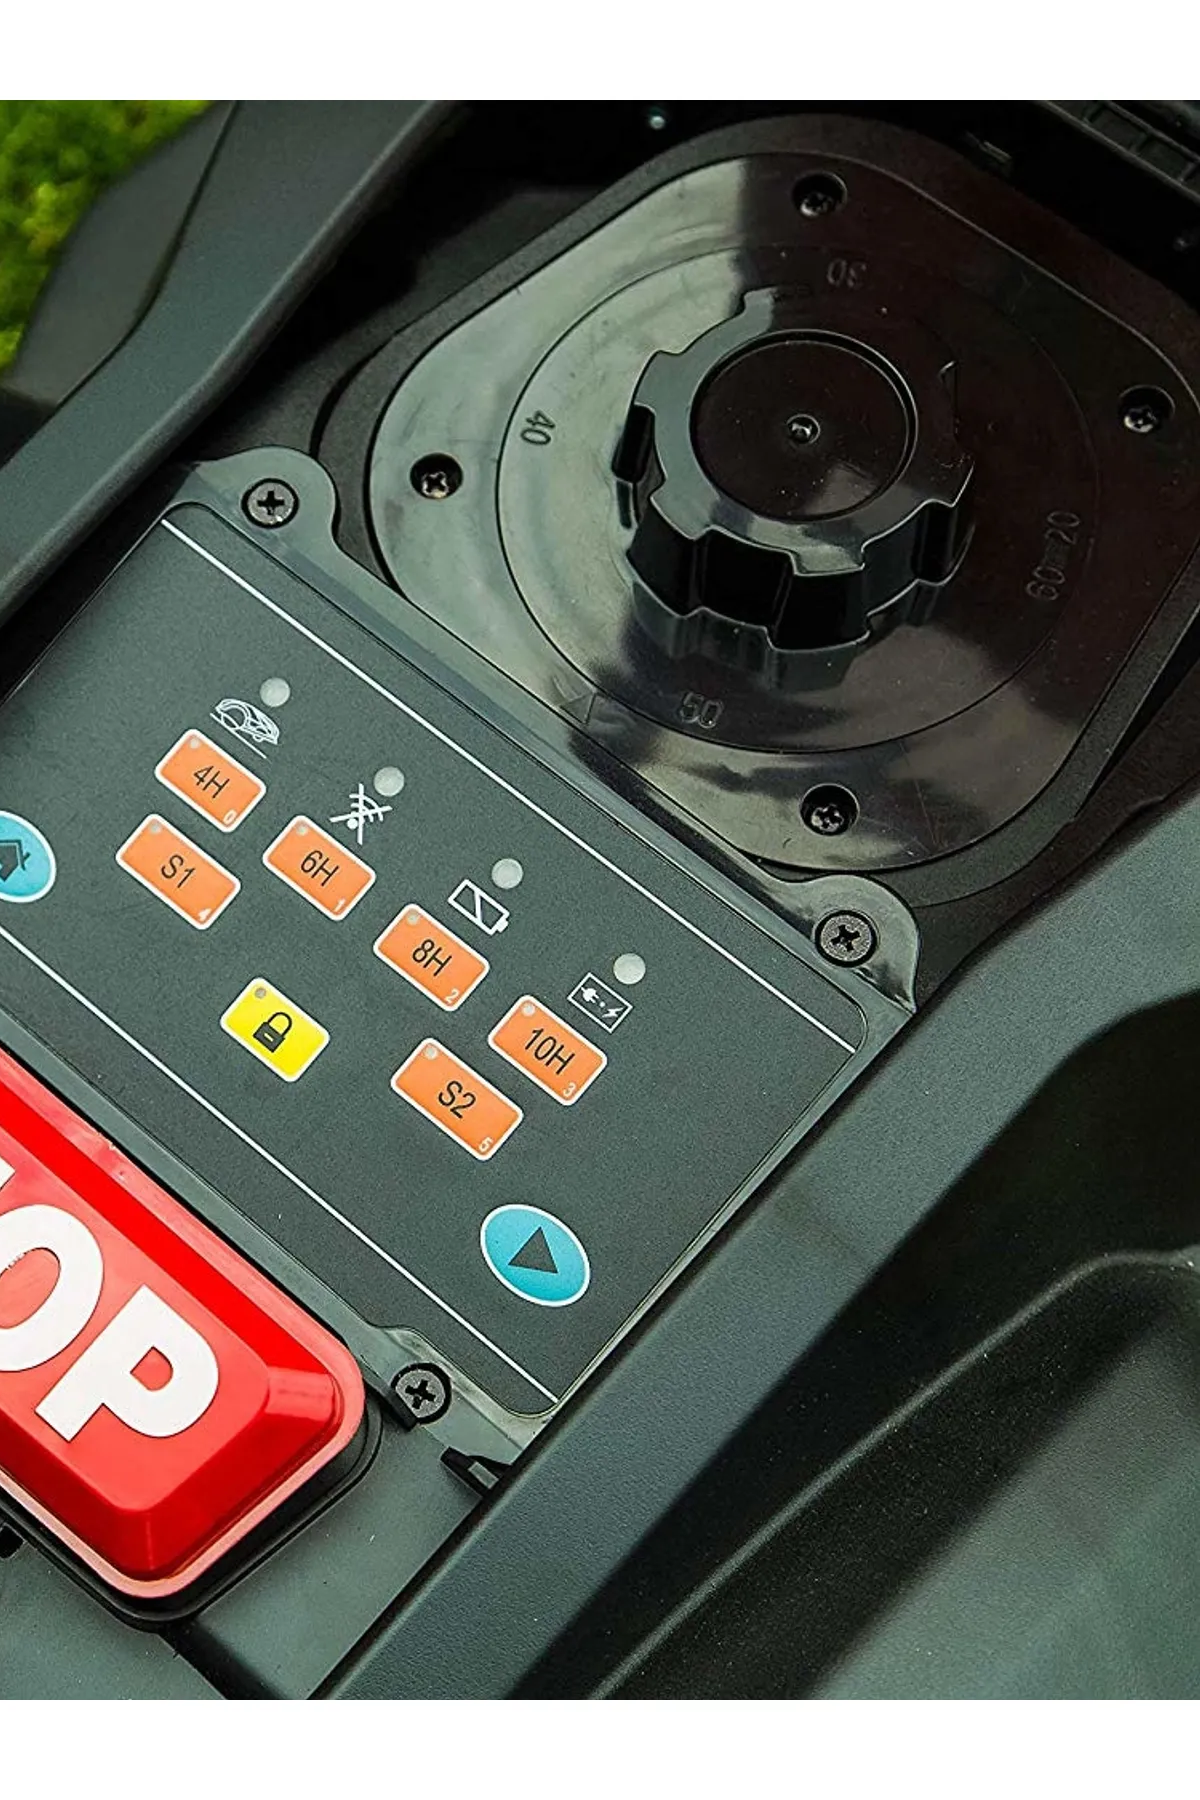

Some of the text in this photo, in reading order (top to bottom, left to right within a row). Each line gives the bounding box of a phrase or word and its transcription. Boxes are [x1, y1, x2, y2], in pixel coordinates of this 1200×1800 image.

[520, 409, 556, 445] 40
[1044, 511, 1081, 545] 20
[1024, 565, 1066, 601] 60
[679, 691, 724, 728] 50
[192, 765, 230, 799] 4H
[222, 809, 237, 825] 0
[160, 854, 197, 889] S1
[300, 850, 340, 887] 6H
[411, 938, 453, 977] 8H
[444, 988, 460, 1004] 2
[523, 1027, 576, 1076] 10H
[437, 1080, 477, 1119] S2
[563, 1082, 577, 1098] 3
[478, 1137, 493, 1152] 5
